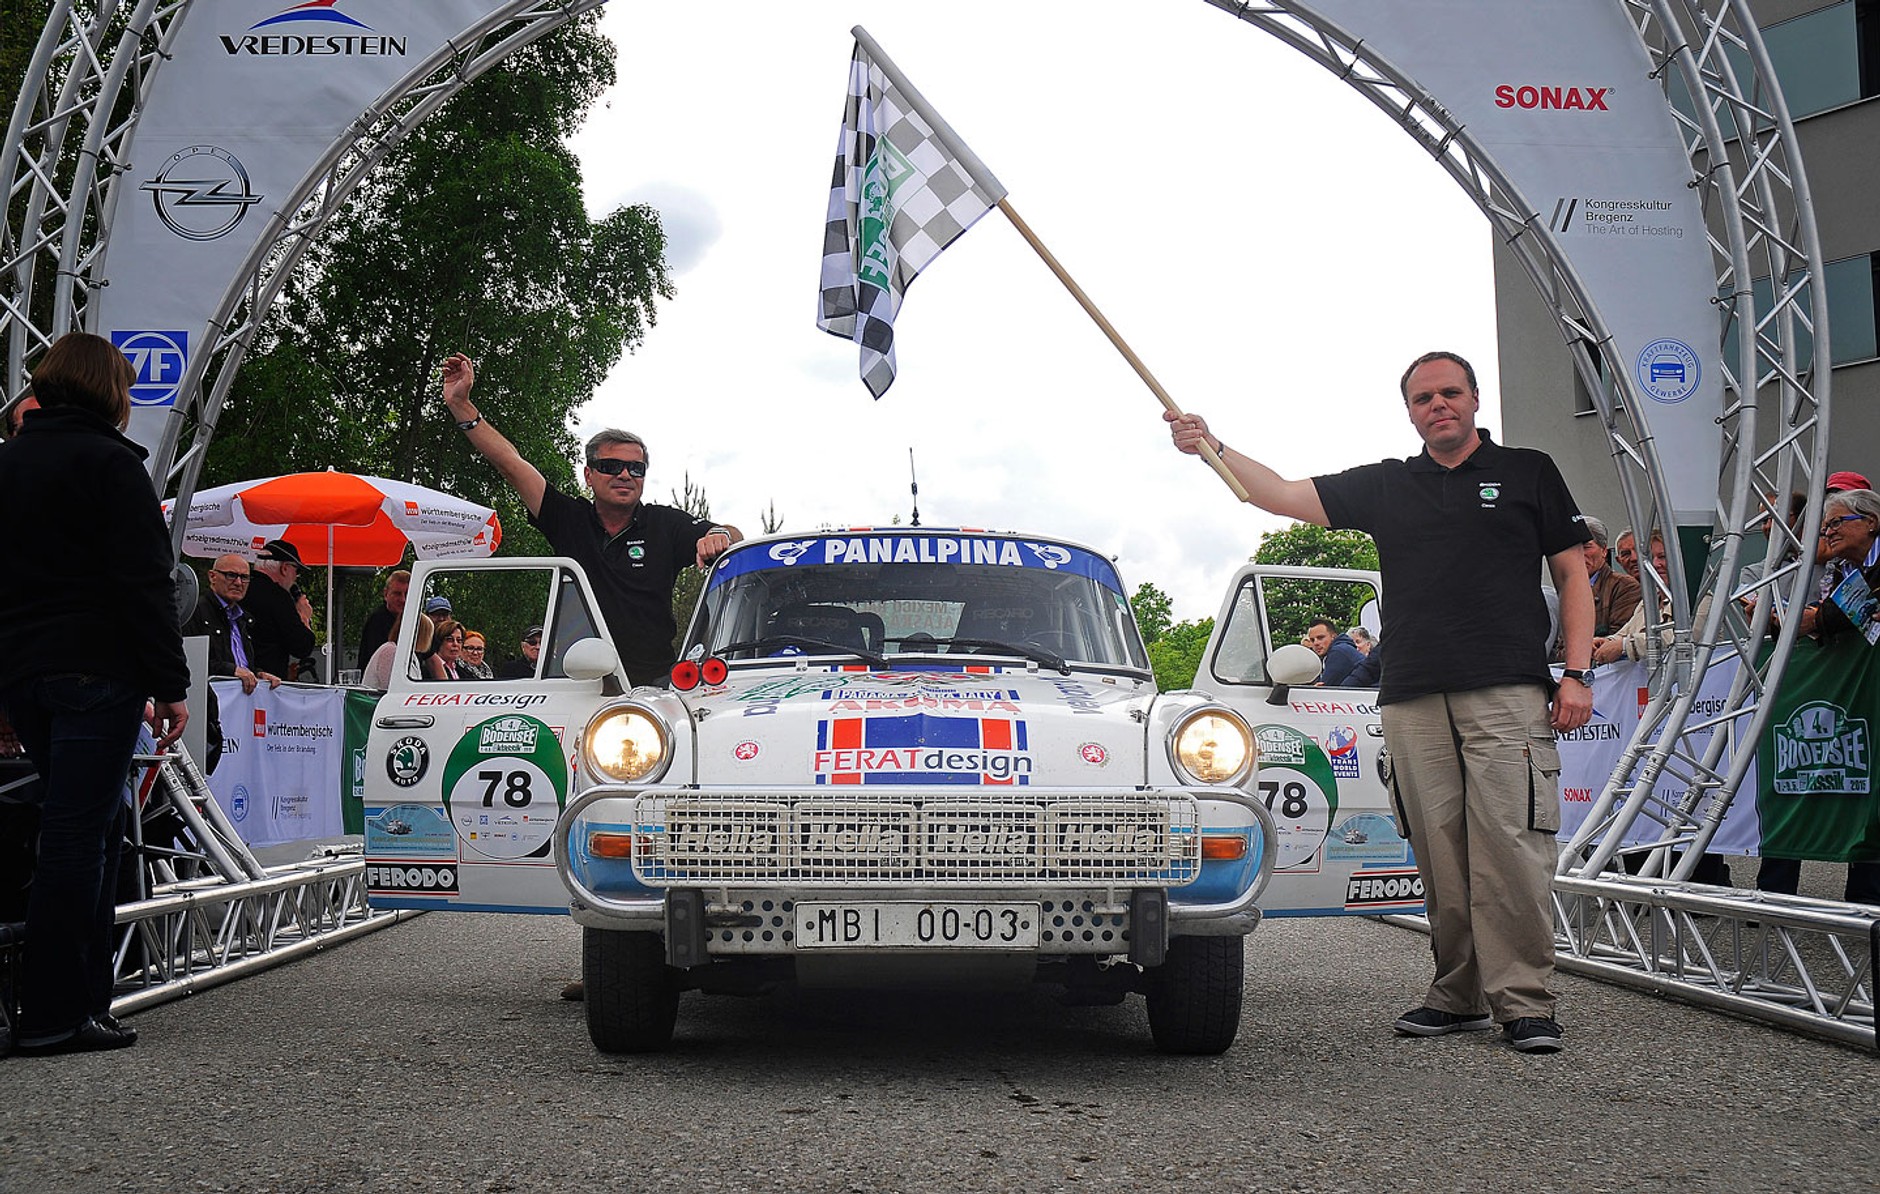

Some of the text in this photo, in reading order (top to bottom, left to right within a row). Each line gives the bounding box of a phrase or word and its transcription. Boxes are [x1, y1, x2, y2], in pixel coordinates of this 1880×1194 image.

[219, 35, 407, 56] VREDESTEIN
[1585, 198, 1672, 210] Kongresskultur
[1586, 211, 1634, 223] Bregenz
[1585, 223, 1683, 239] The Art of Hosting
[1641, 343, 1695, 369] KRAFTFAHRZEUG
[1649, 384, 1688, 398] GEWERBE
[824, 537, 1024, 567] PANALPINA
[404, 693, 548, 709] FERATdesign
[1290, 701, 1380, 715] FERATde
[267, 722, 334, 741] württembergische
[1812, 710, 1828, 735] 4.
[481, 727, 538, 745] BODENSEE
[1776, 726, 1868, 774] BODENSEE
[814, 749, 1032, 779] FERATdesign
[394, 775, 419, 785] AUTO
[478, 770, 533, 808] 78
[1258, 781, 1308, 819] 78
[1563, 787, 1592, 802] SONAX
[677, 823, 774, 852] Hella
[806, 823, 903, 852] Hella
[936, 823, 1031, 853] Hella
[1060, 823, 1158, 852] Hella
[367, 867, 455, 888] FERODO
[1348, 878, 1426, 900] FERODO
[917, 909, 1018, 942] 00-03
